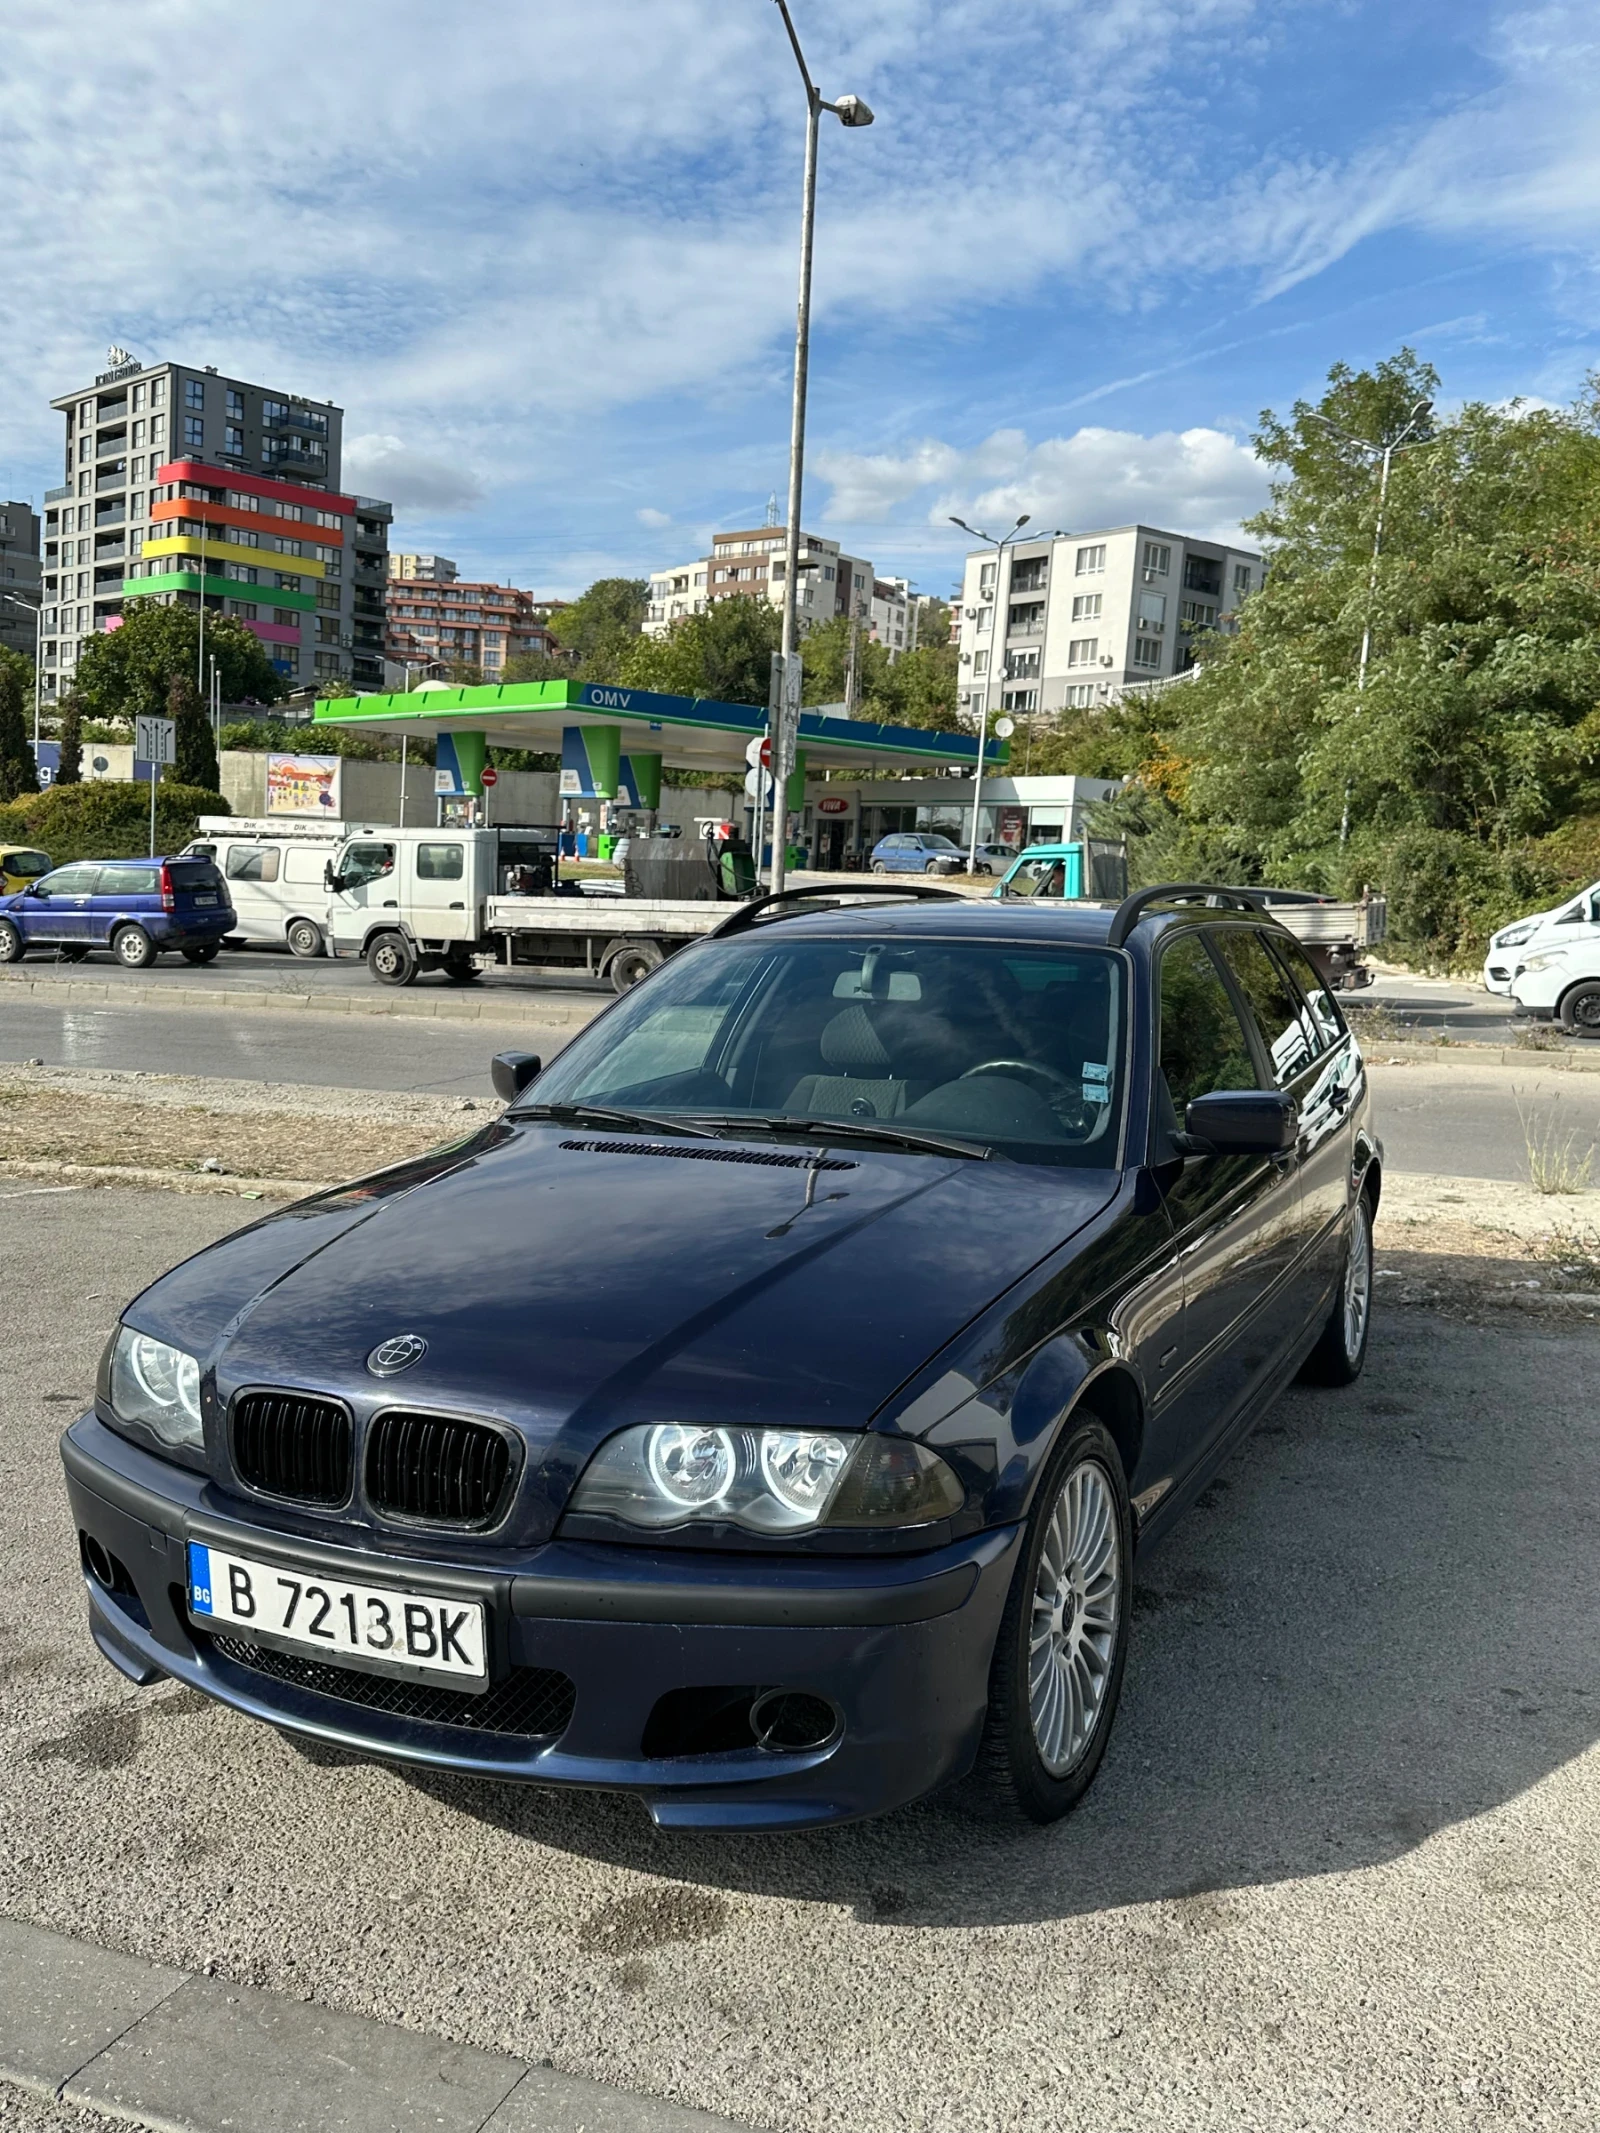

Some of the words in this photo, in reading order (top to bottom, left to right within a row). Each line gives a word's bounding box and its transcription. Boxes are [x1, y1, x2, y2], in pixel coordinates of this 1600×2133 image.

[591, 689, 631, 709] OMV
[822, 800, 841, 811] VIVA
[194, 1586, 210, 1604] BG
[228, 1563, 256, 1618] B
